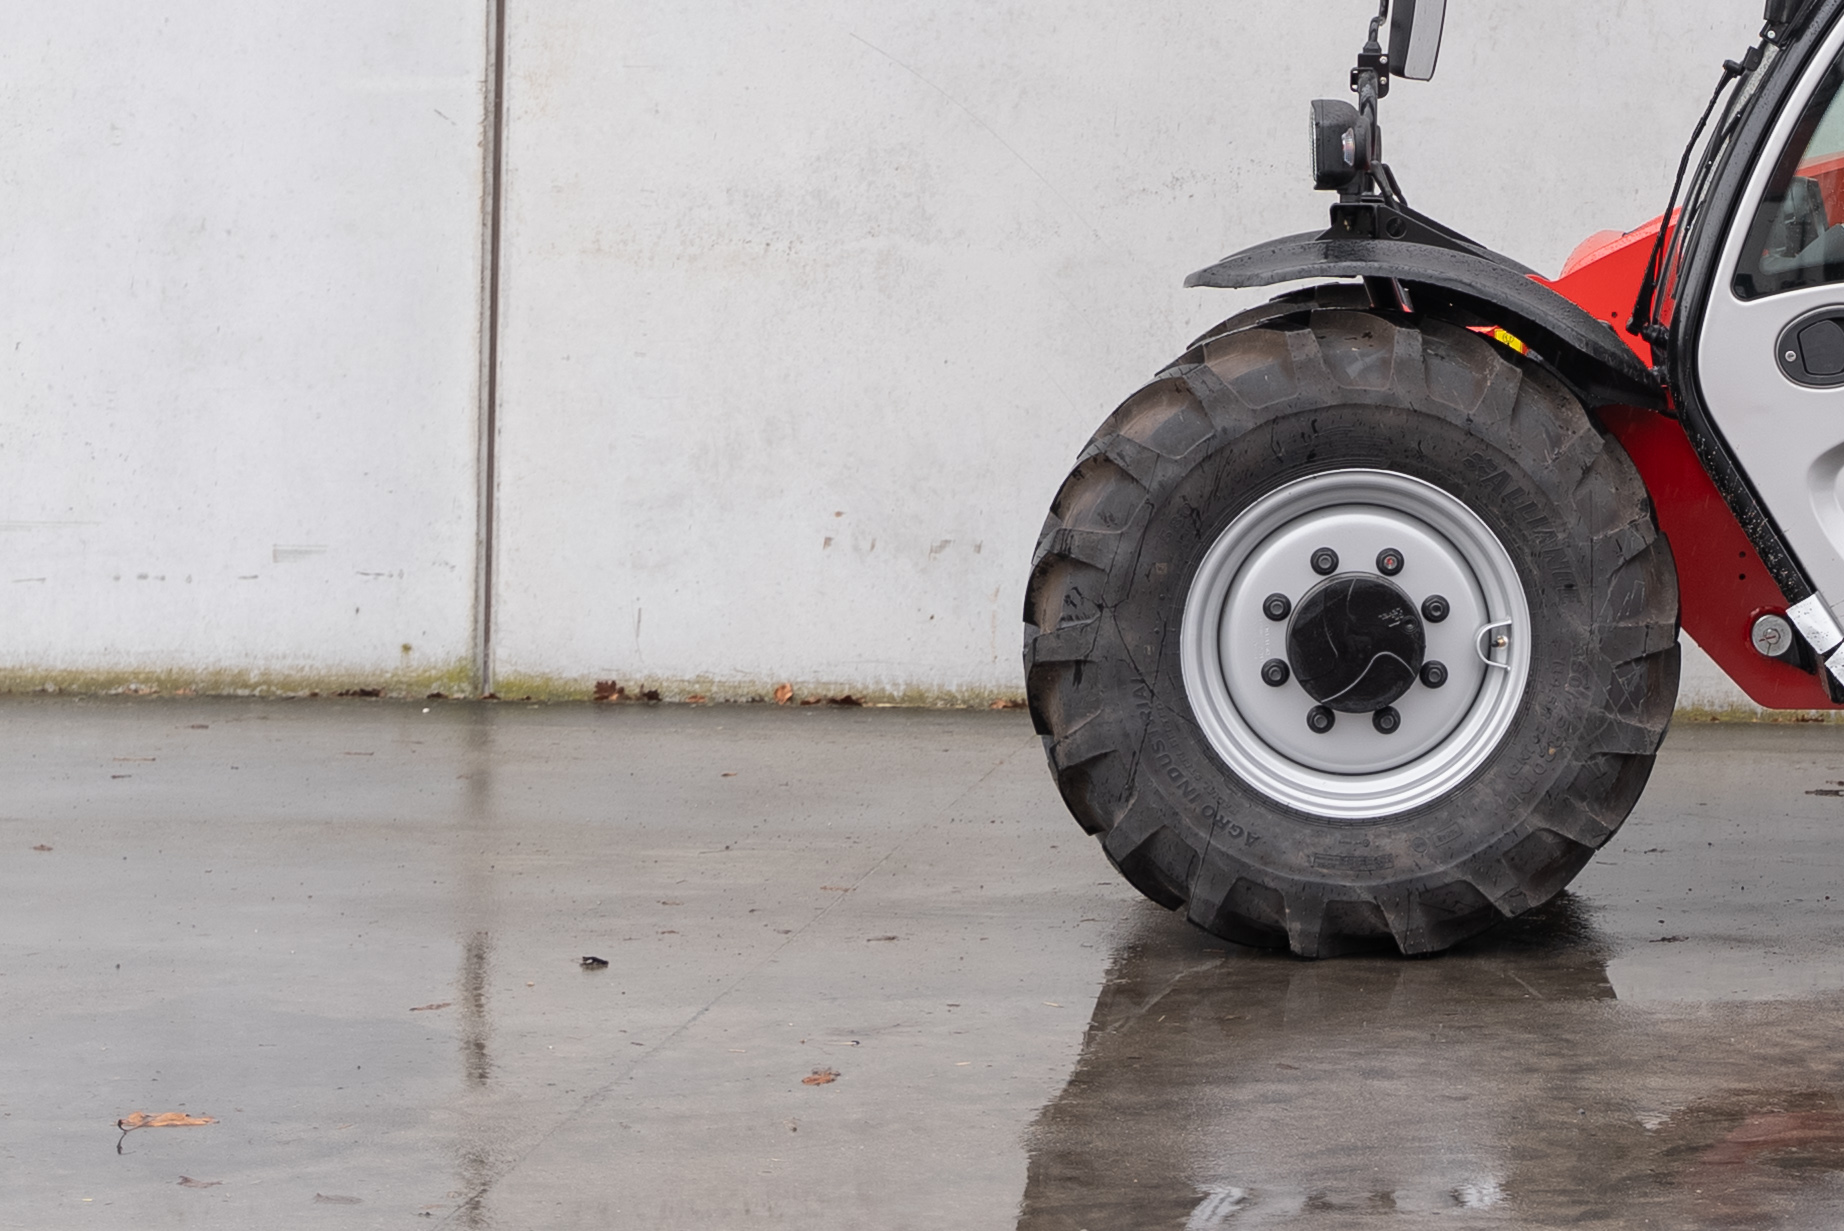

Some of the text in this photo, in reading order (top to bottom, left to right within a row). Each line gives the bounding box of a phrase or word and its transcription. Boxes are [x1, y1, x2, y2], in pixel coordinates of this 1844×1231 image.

[1479, 459, 1583, 608] ALLIANCE
[1128, 674, 1262, 851] AGRO INDUSTRIAL
